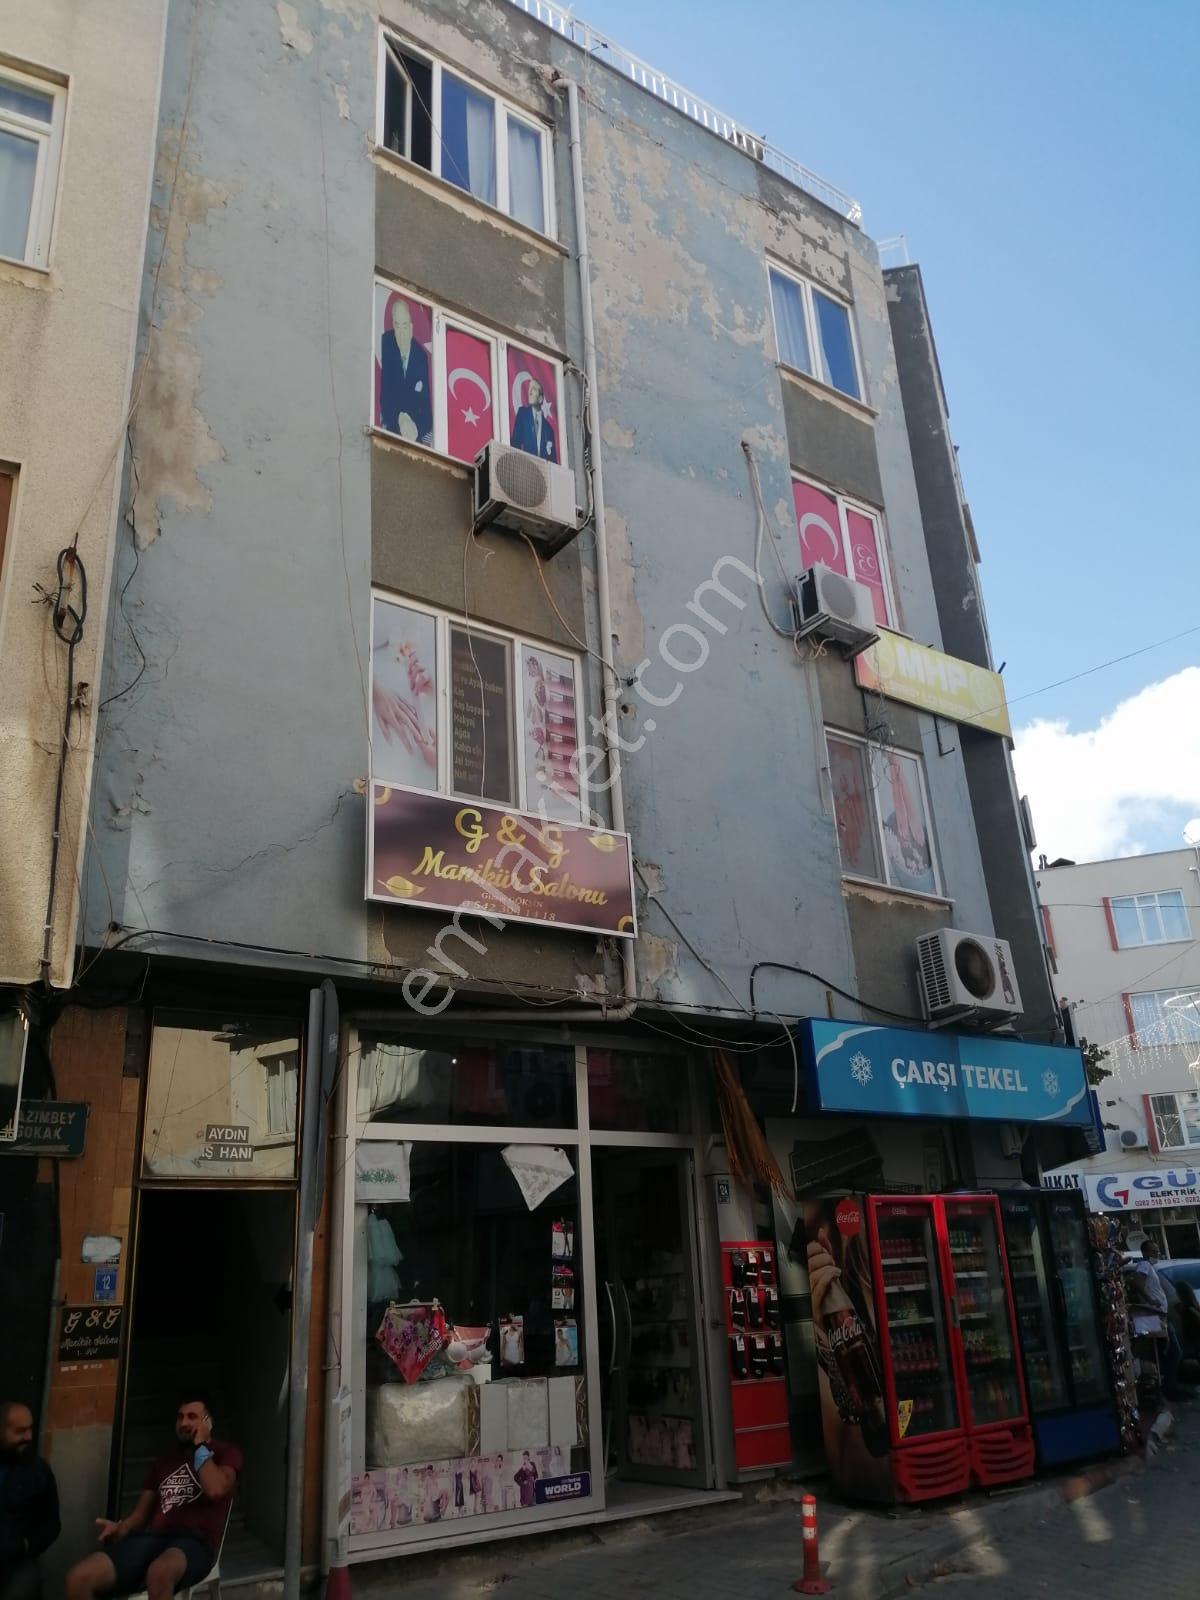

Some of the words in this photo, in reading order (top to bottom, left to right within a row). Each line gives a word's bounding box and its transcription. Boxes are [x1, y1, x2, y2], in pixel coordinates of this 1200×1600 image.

[895, 643, 967, 694] MHP
[454, 808, 489, 853] G
[496, 815, 526, 845] &
[540, 825, 569, 868] G
[529, 865, 609, 906] Salonu
[891, 1058, 957, 1092] ÇARŞI
[961, 1064, 1028, 1092] TEKEL
[19, 1109, 76, 1125] AZIMBEY
[219, 1146, 252, 1159] HANI
[1043, 1174, 1079, 1189] UKAT
[1132, 1169, 1200, 1189] GÜ
[1150, 1188, 1197, 1198] ELEKTRİK
[102, 1275, 111, 1290] 12
[64, 1312, 82, 1334] G
[85, 1309, 103, 1327] &
[102, 1308, 121, 1329] G
[544, 1482, 582, 1495] WORLD
